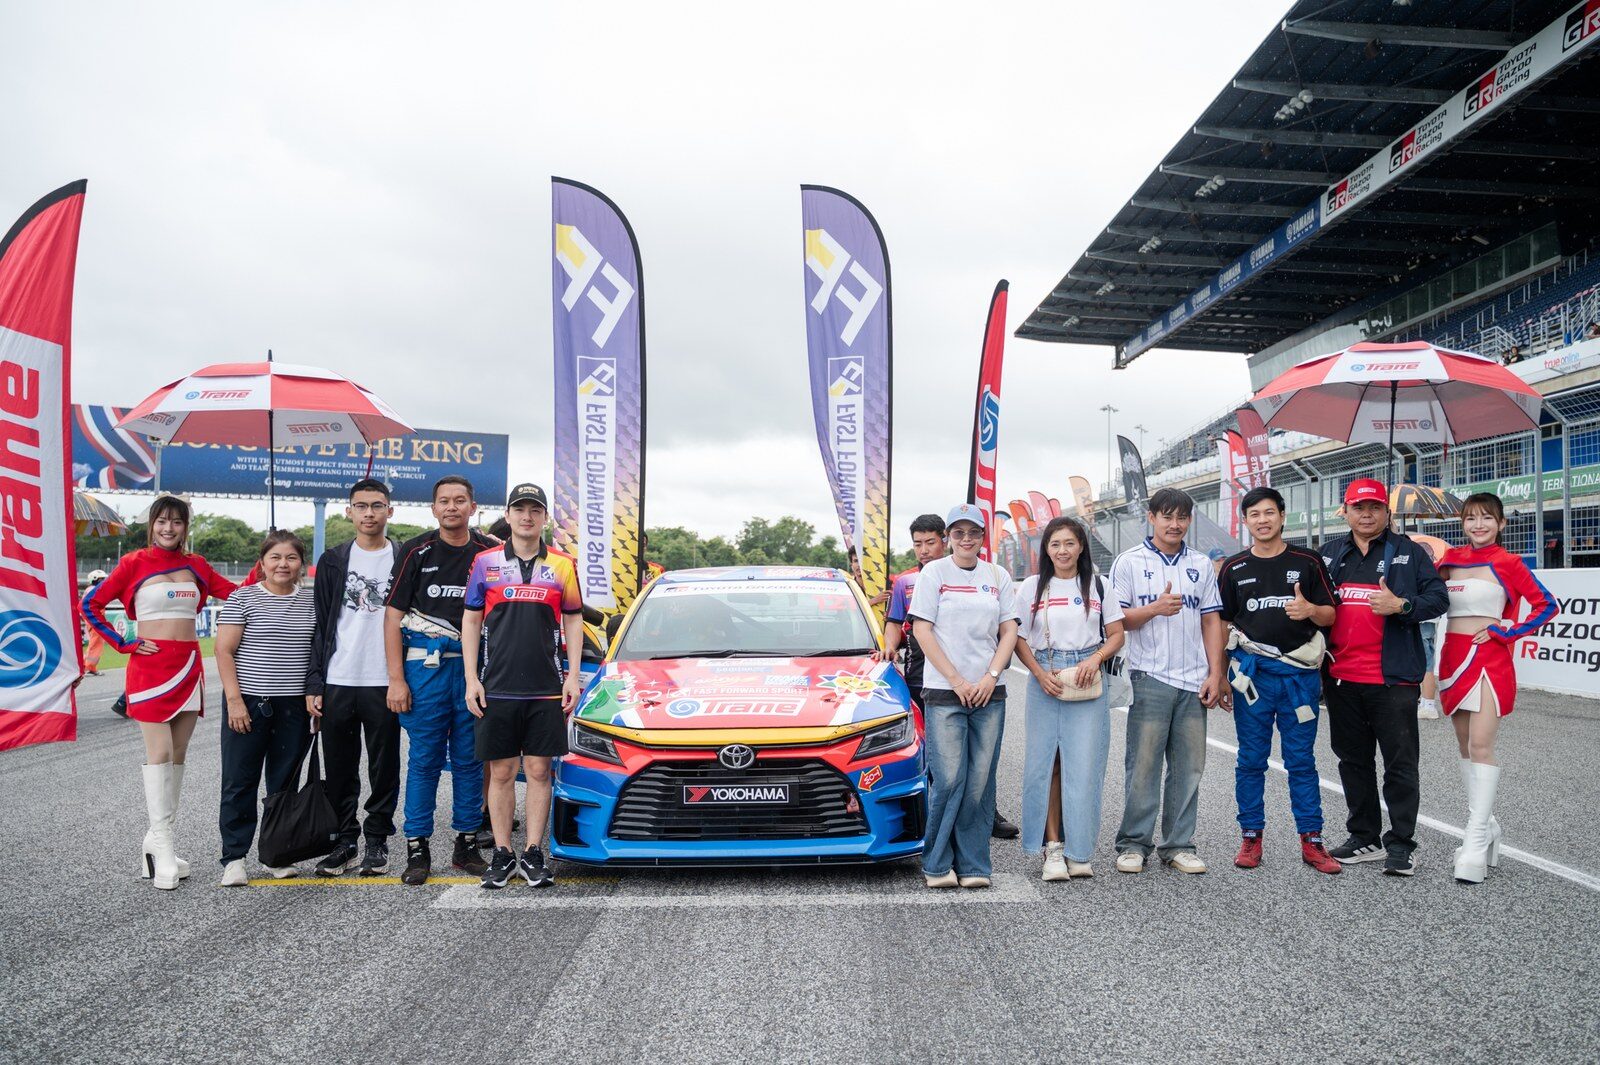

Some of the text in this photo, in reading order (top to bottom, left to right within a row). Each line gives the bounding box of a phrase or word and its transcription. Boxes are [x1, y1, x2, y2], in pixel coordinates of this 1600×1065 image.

[1499, 42, 1537, 73] TOYOTA
[1497, 56, 1532, 86] GAZOO
[1495, 69, 1530, 97] Racing
[1464, 81, 1494, 119] GR
[1417, 109, 1447, 135] TOYOTA
[1416, 121, 1443, 145] GAZOO
[1415, 132, 1442, 155] Racing
[1389, 141, 1415, 173] GR
[1327, 189, 1347, 214] GR
[1366, 362, 1420, 371] Trane
[200, 390, 252, 399] Trane
[410, 438, 484, 465] KING
[275, 458, 305, 466] UTMOST
[307, 460, 336, 468] RESPECT
[338, 461, 358, 469] FROM
[316, 467, 341, 475] CHANG
[294, 481, 342, 489] INTERNATIONAL
[1497, 480, 1531, 499] Chang
[440, 585, 467, 598] Tra
[514, 587, 547, 599] Trane
[1343, 587, 1376, 600] Tran
[1138, 594, 1200, 609] THAND
[1258, 596, 1294, 610] Tran
[1557, 598, 1600, 615] YOT
[1535, 622, 1600, 640] AZOO
[1521, 641, 1600, 672] Racing
[703, 700, 799, 714] Trane
[711, 787, 786, 800] YOKOHAMA
